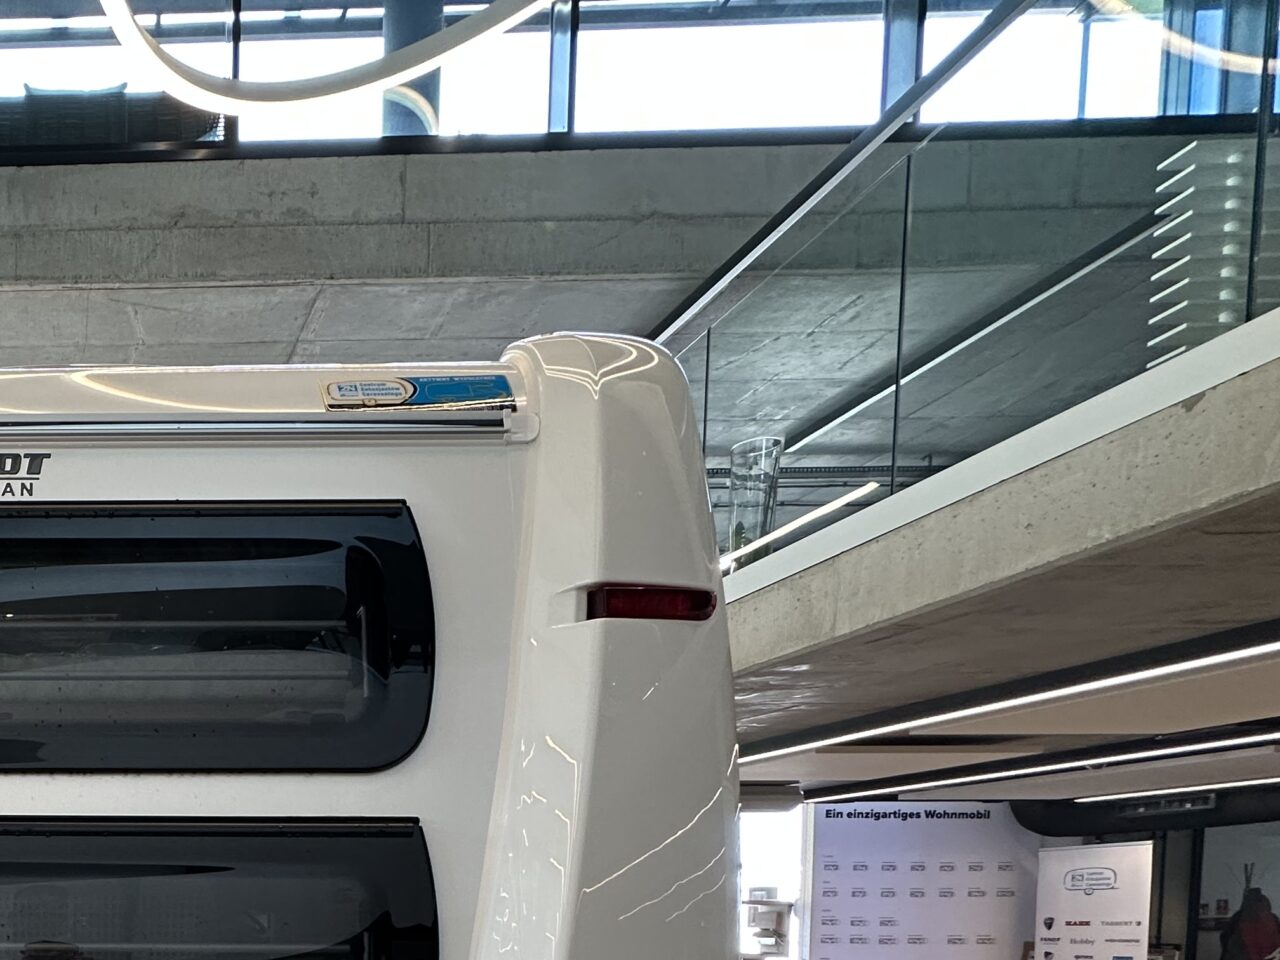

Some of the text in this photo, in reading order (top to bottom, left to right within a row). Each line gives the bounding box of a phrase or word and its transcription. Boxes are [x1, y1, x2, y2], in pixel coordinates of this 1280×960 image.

[825, 809, 991, 821] Ein einzigartiges Wohnmobil
